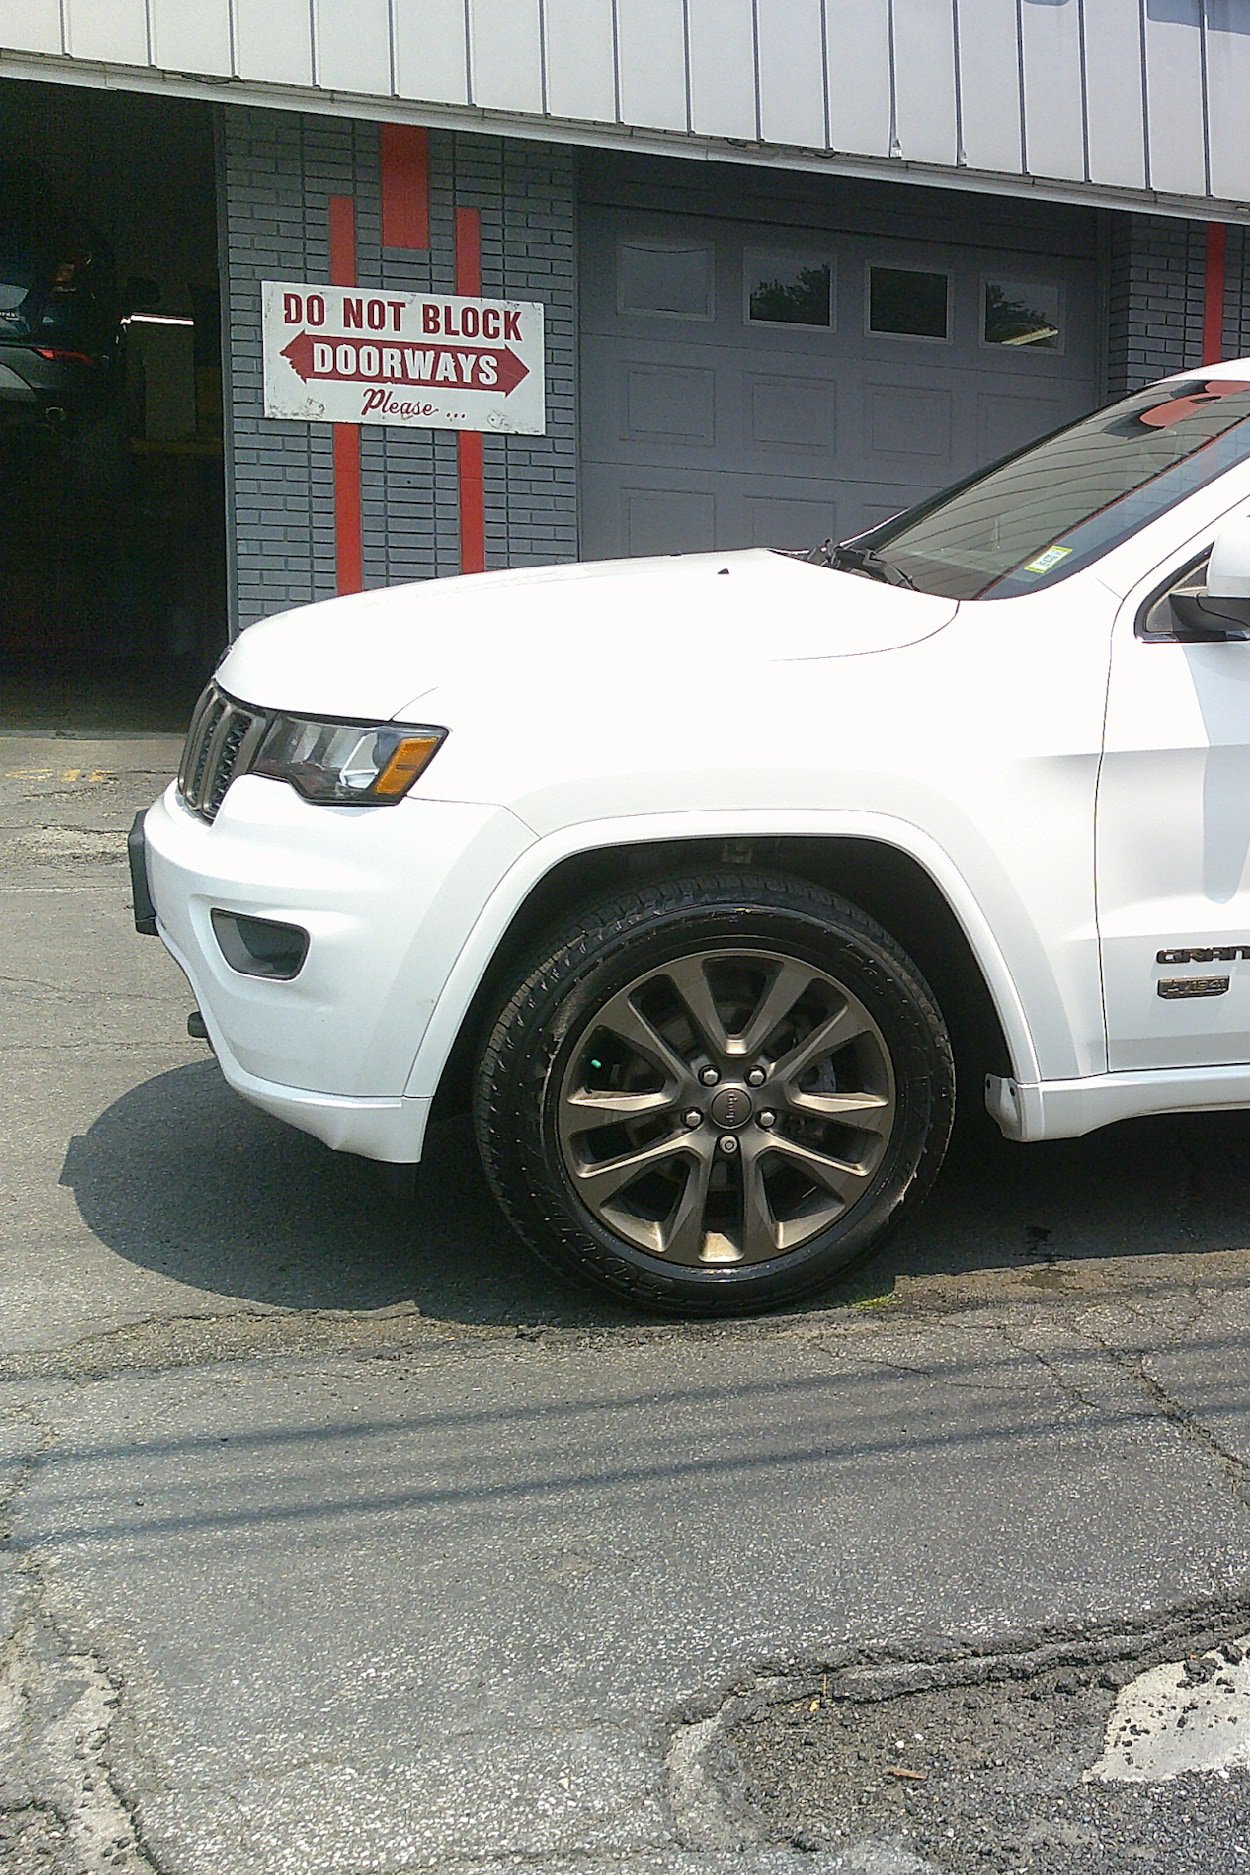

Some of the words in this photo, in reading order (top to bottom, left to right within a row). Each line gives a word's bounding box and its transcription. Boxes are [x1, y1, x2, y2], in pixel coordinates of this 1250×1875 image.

[283, 293, 326, 327] DO
[343, 297, 406, 332] NOT
[422, 303, 523, 341] BLOCK
[313, 342, 498, 385] DOORWAYS
[361, 388, 439, 417] Please
